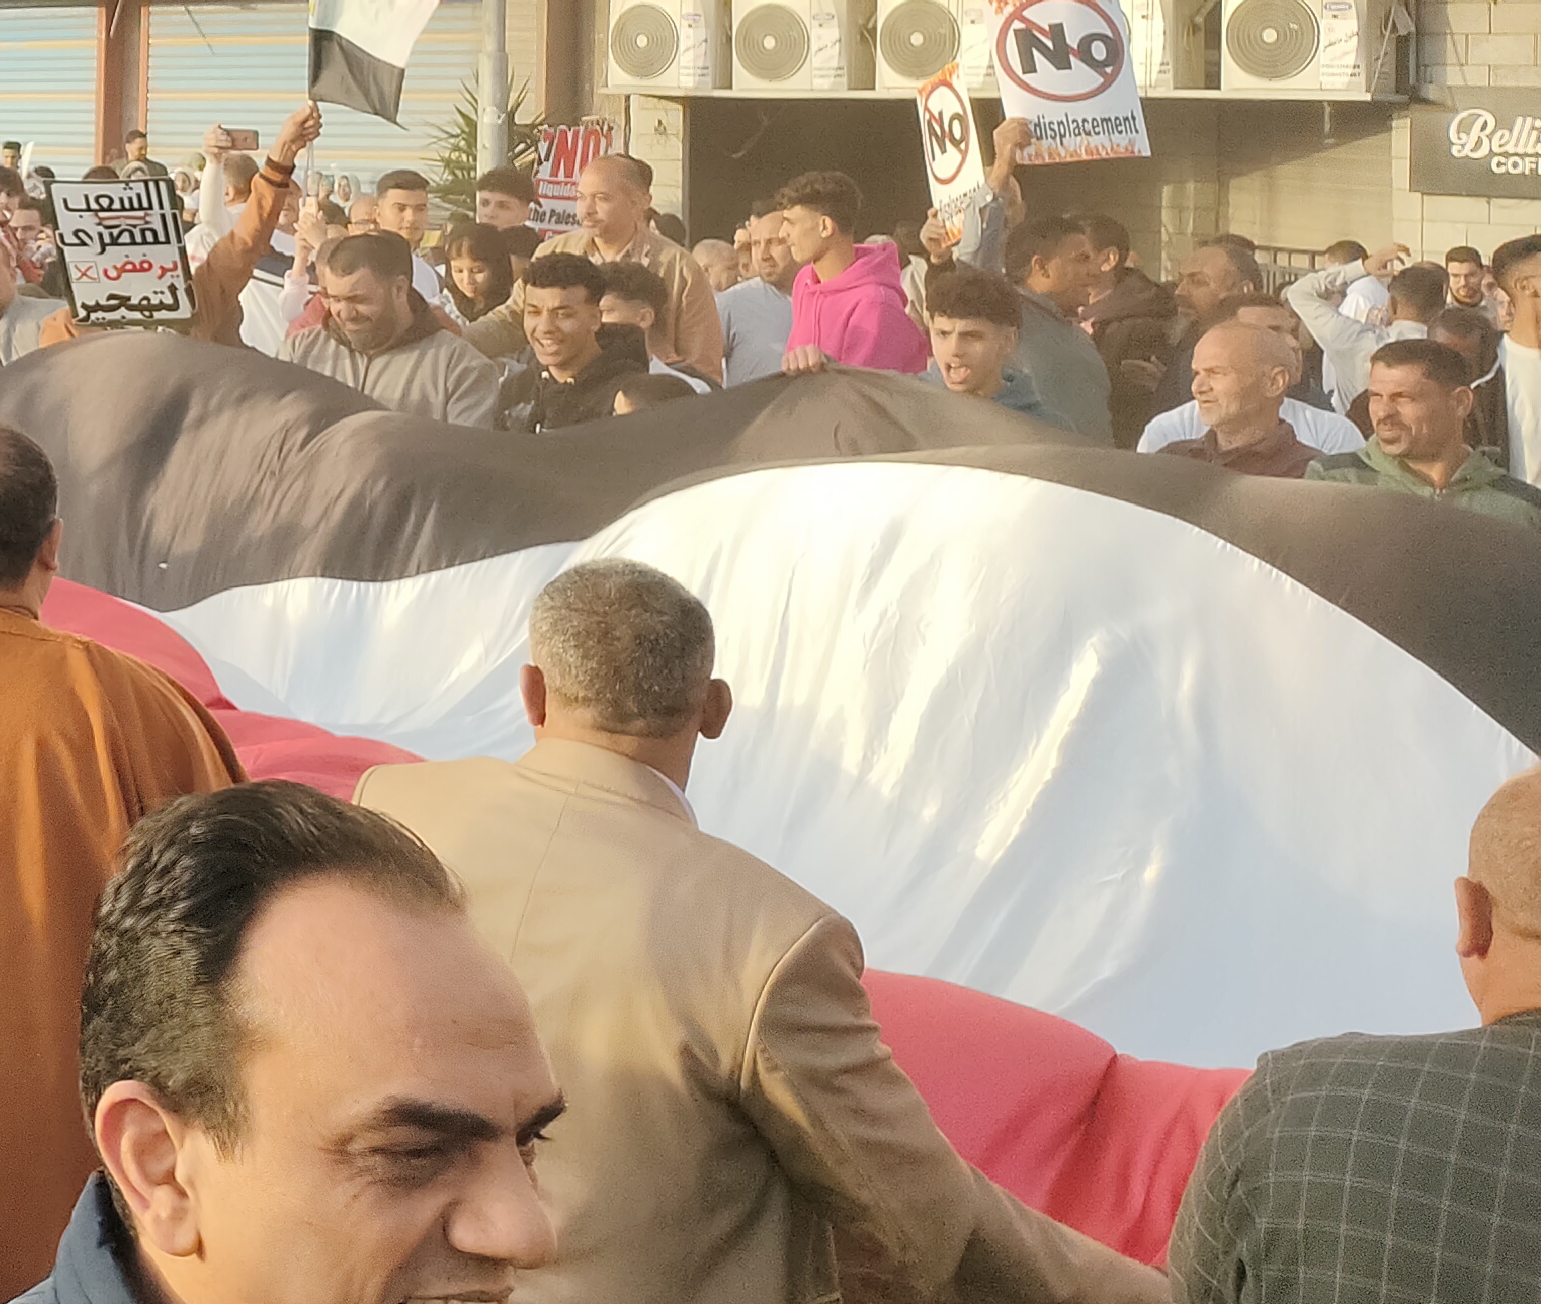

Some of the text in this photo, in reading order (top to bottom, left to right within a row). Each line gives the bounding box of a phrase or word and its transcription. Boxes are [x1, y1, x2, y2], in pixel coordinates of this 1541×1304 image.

[1032, 112, 1140, 143] displacement
[1449, 108, 1541, 159] Belli
[61, 180, 165, 219] الشعب
[102, 252, 180, 281] يرفض
